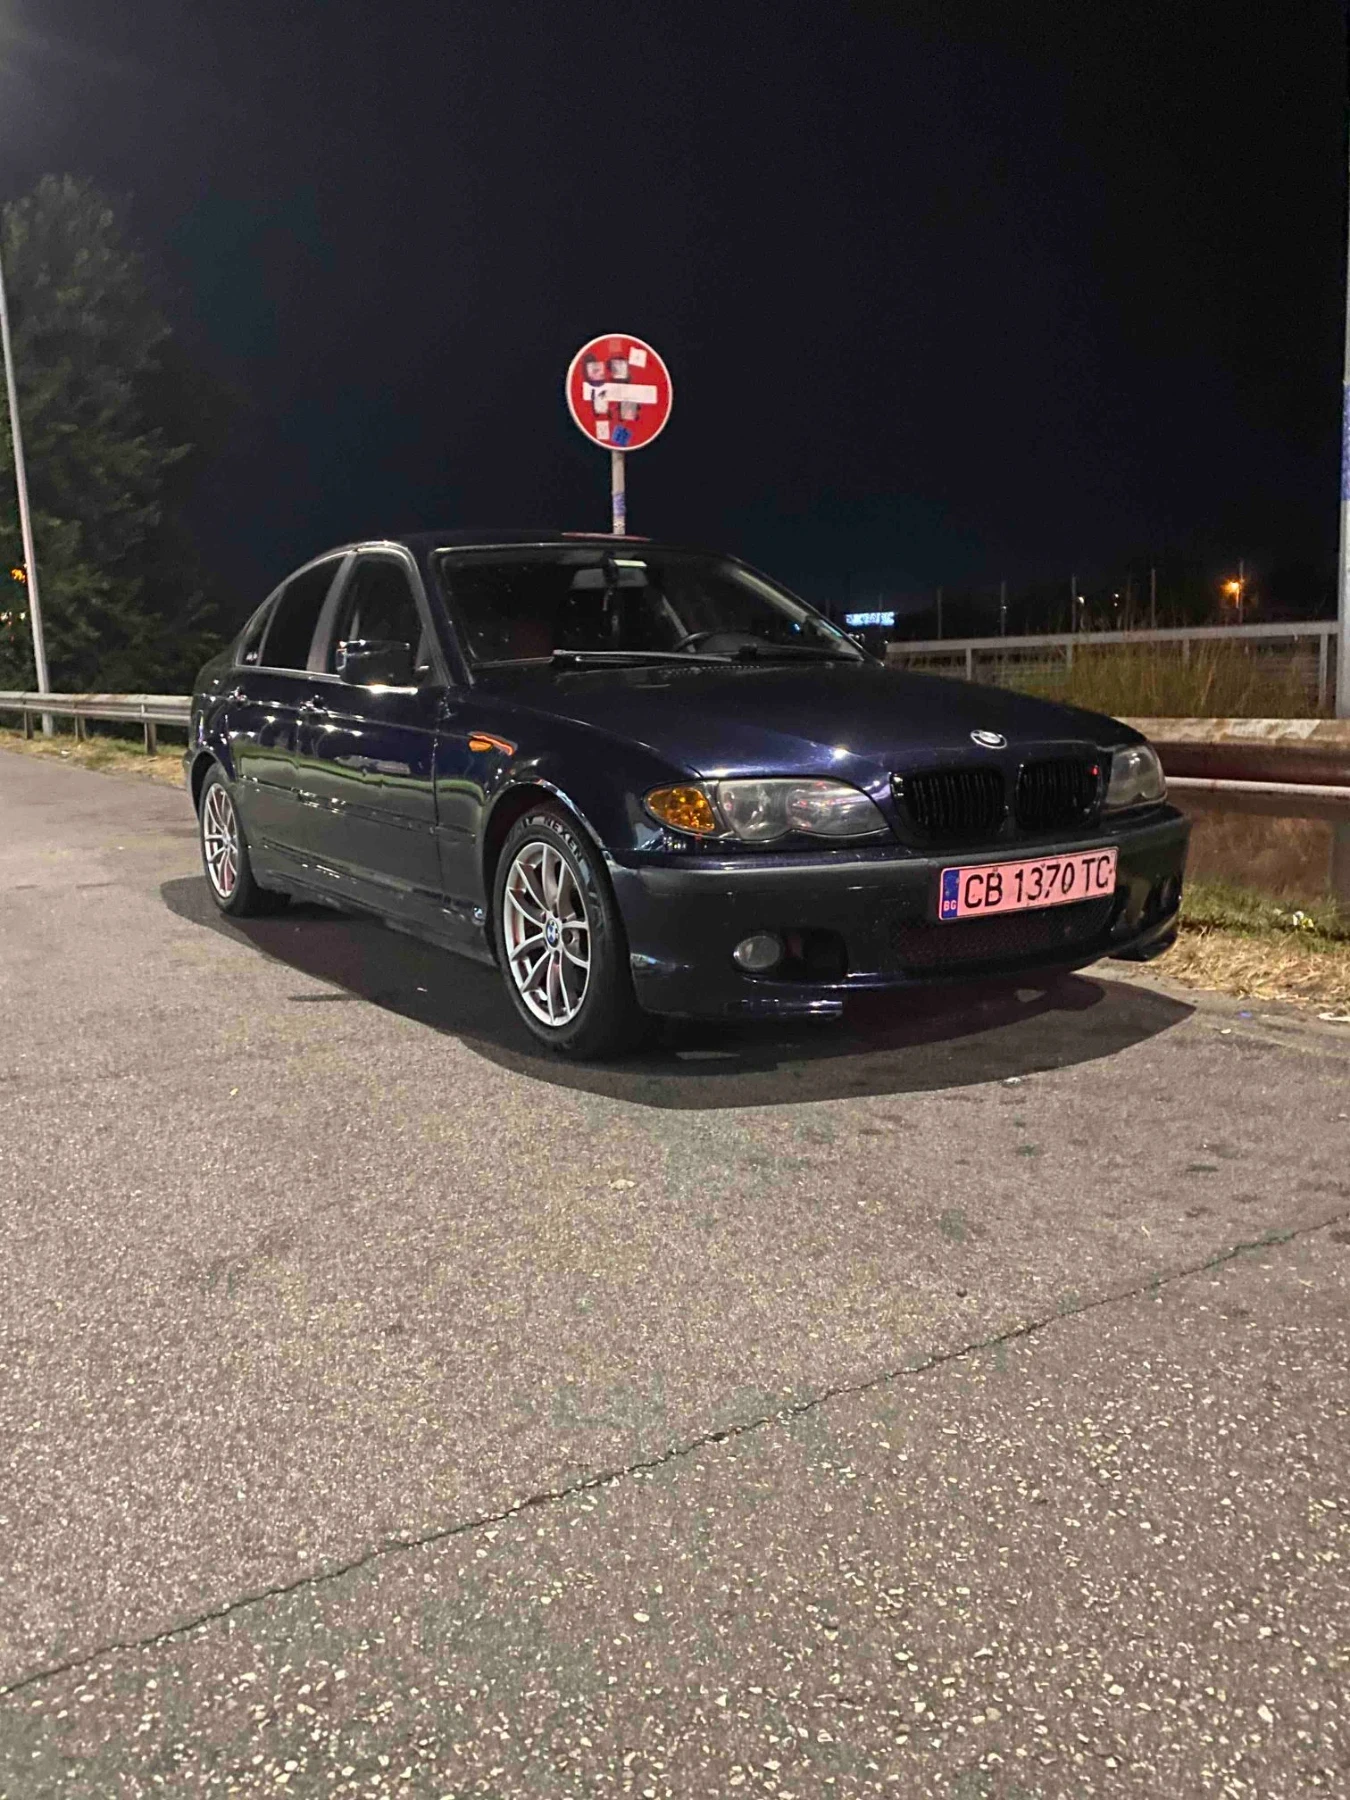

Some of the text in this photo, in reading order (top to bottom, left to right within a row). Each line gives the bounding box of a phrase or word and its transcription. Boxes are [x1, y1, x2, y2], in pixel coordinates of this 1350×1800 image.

[543, 817, 583, 862] NEXEN
[964, 855, 1110, 908] CB 1370 TC
[943, 900, 957, 911] BG
